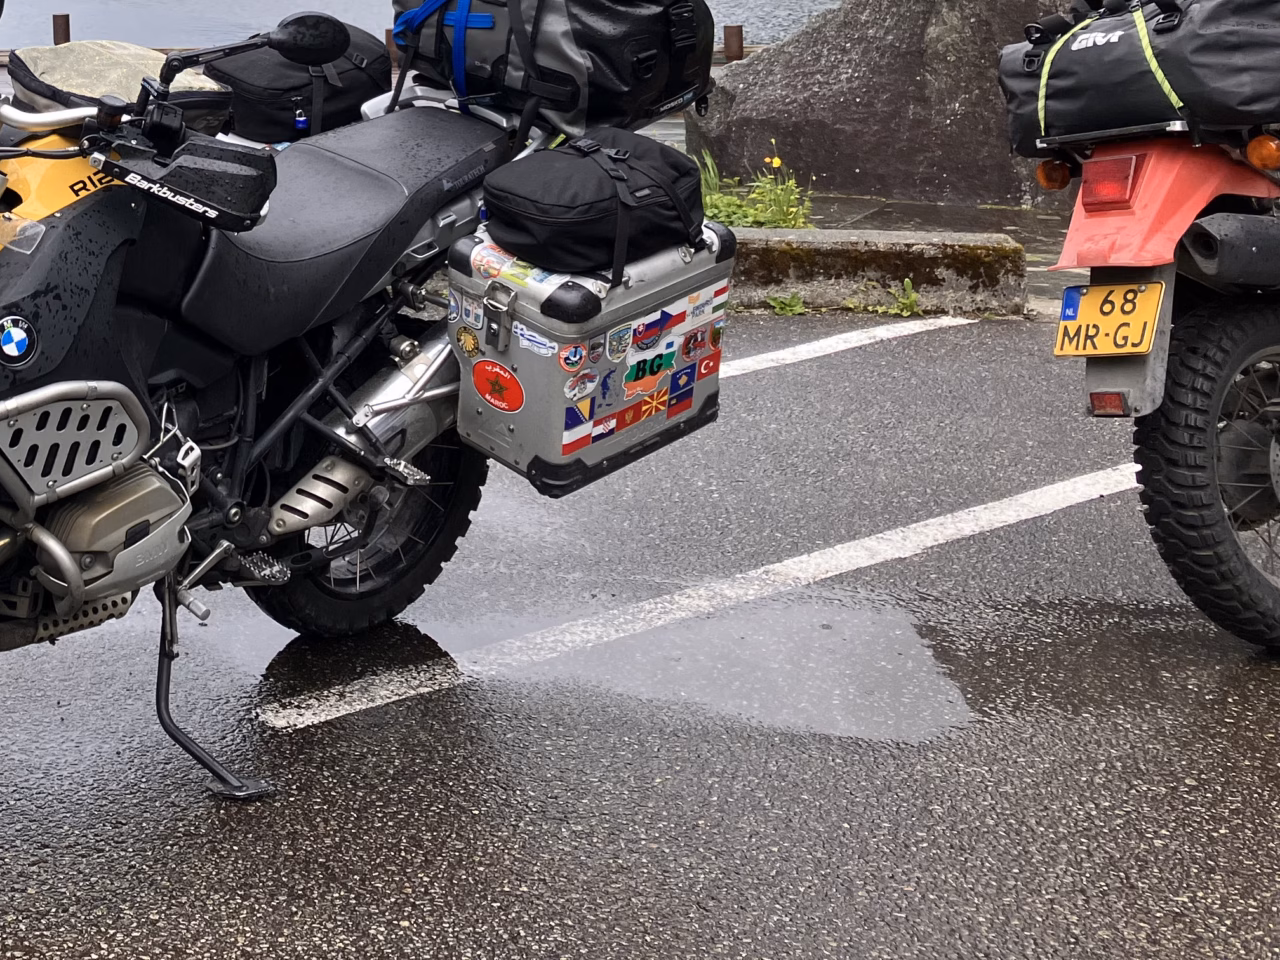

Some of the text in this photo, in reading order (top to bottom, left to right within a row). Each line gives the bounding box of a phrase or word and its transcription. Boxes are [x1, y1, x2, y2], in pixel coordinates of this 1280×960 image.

[124, 172, 220, 219] Barkbusters
[1065, 288, 1139, 317] NL 68
[1059, 321, 1148, 352] MR-GJ
[632, 353, 664, 383] BG
[485, 393, 509, 409] MAROC
